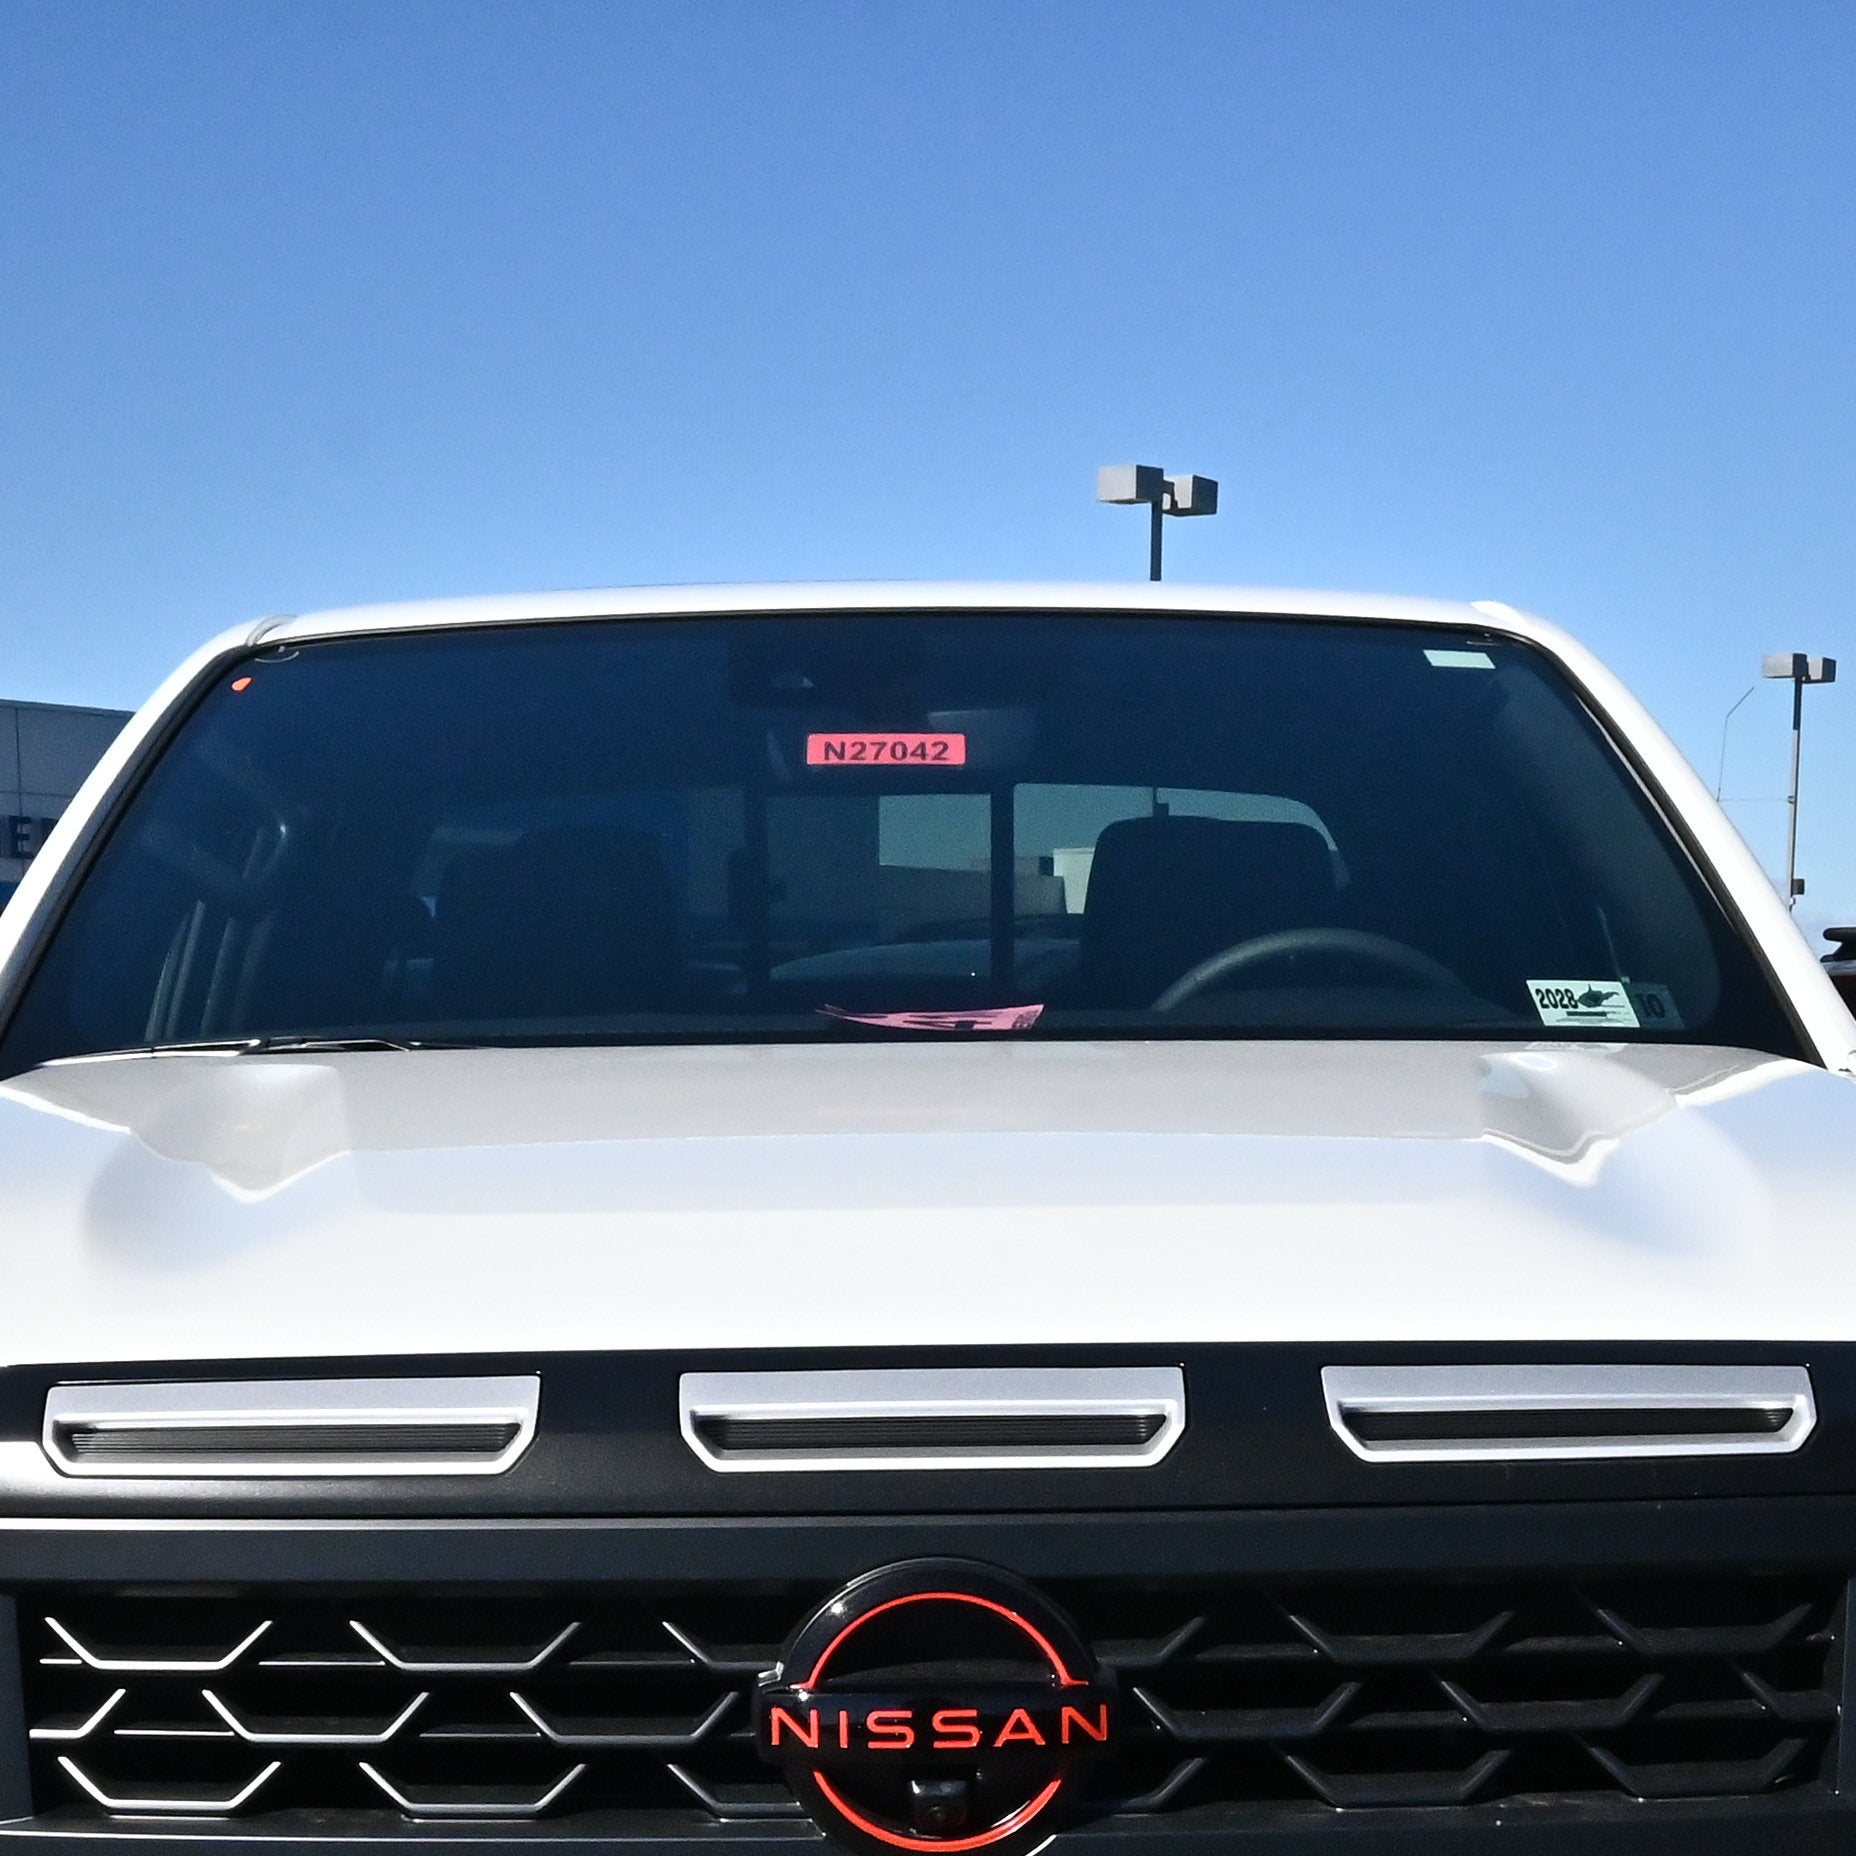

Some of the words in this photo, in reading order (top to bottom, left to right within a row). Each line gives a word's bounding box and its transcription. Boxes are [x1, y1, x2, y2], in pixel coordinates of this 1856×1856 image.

[823, 741, 949, 761] N27042
[1535, 988, 1579, 1009] 2028
[771, 1705, 1108, 1749] NISSAN
